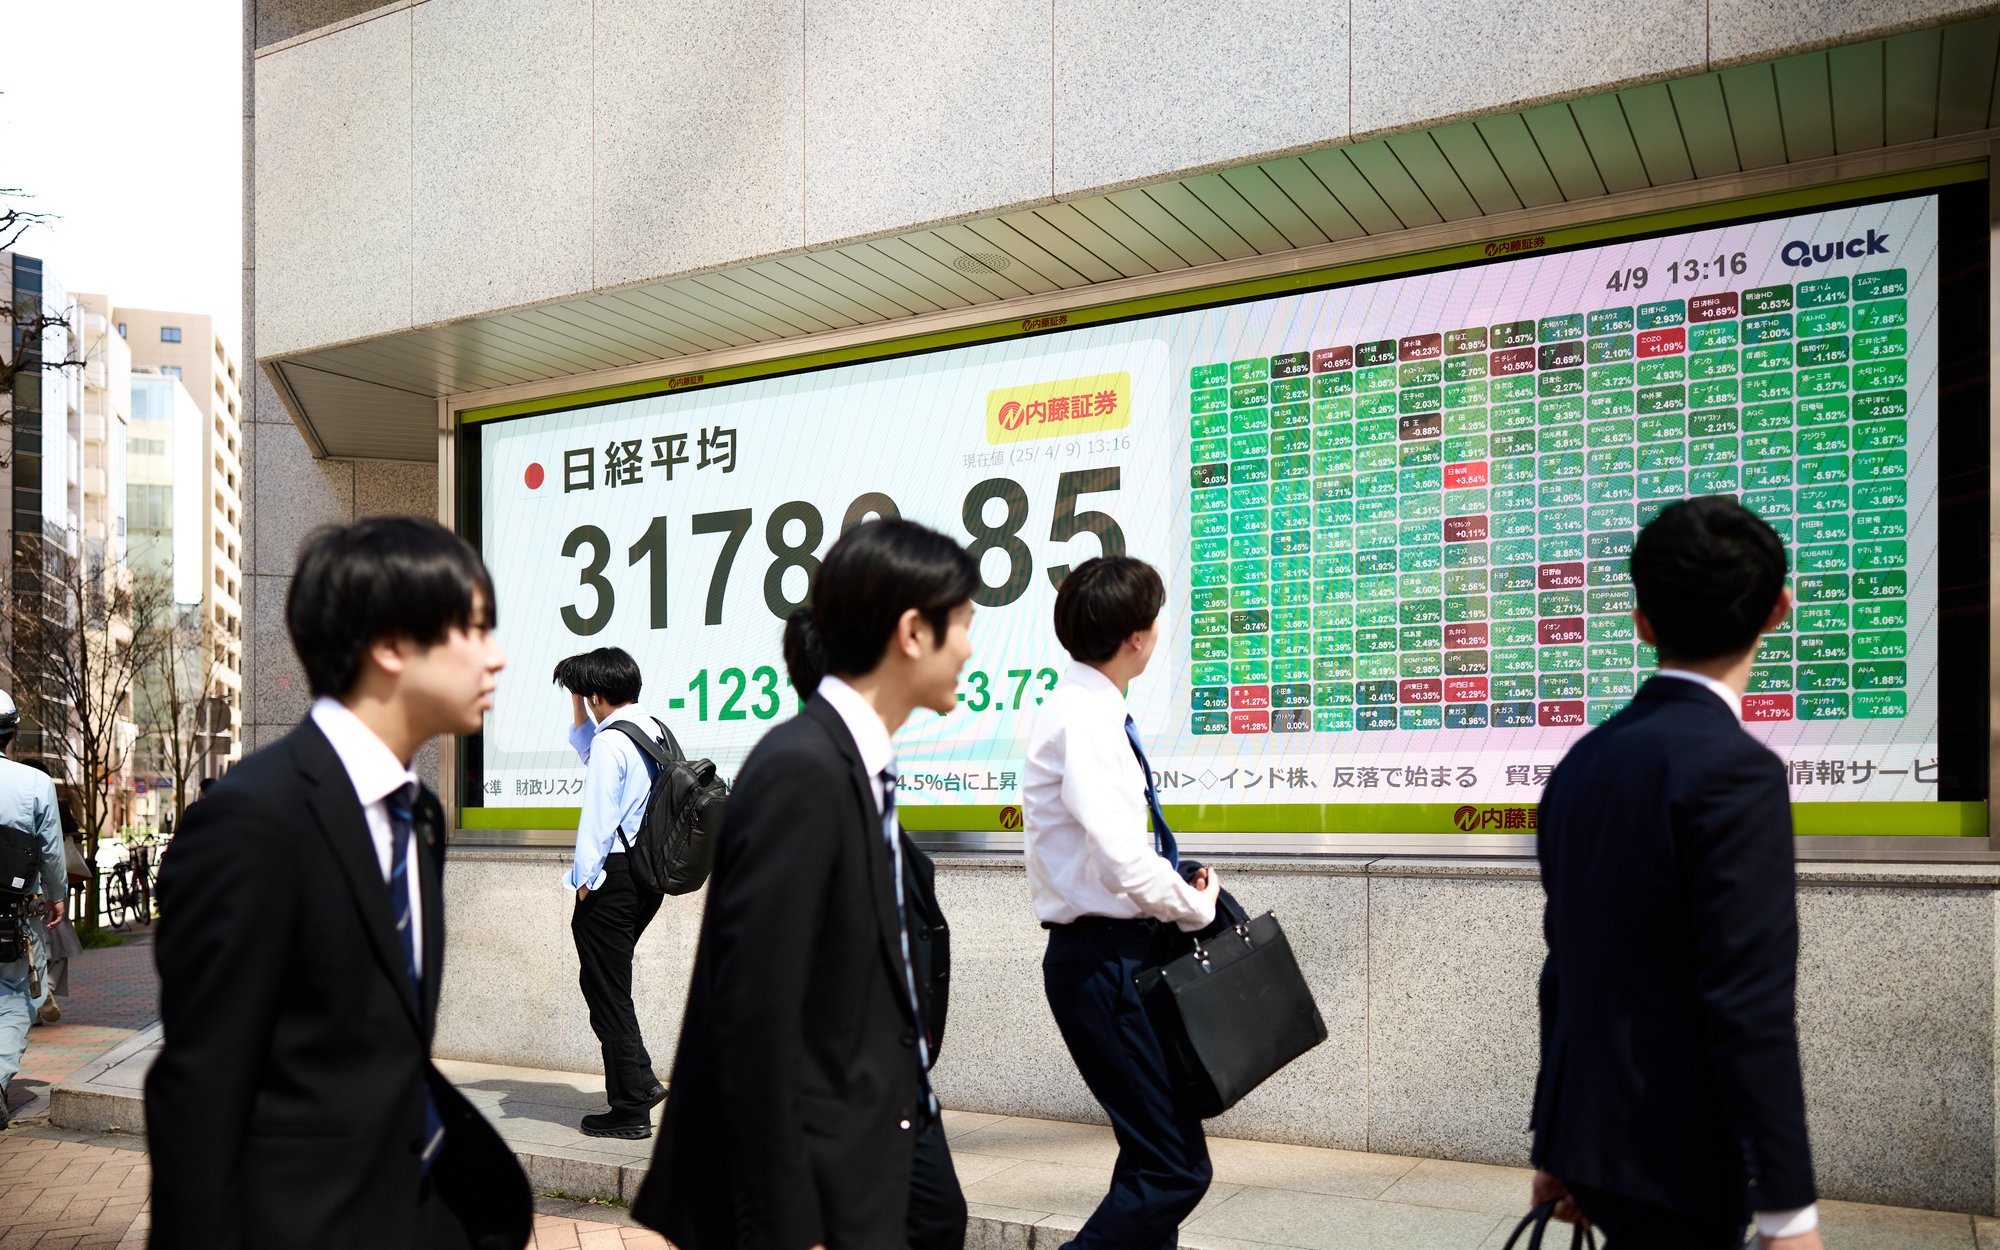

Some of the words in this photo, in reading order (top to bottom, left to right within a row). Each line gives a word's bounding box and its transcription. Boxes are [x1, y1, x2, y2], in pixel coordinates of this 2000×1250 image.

[1499, 236, 1546, 253] 内藤証券
[1606, 266, 1648, 293] 4/9
[1667, 252, 1747, 285] 13:16
[1801, 283, 1830, 293] 日本ハム
[1869, 283, 1904, 296] -2.88%
[1813, 291, 1846, 303] -1.41%
[1758, 299, 1790, 310] -0.53%
[1702, 306, 1735, 318] +0.69%
[1032, 314, 1068, 330] 内藤証券
[1652, 313, 1682, 324] -2.93%
[1869, 314, 1904, 326] -7.88%
[1813, 321, 1846, 333] -3.38%
[1641, 335, 1661, 343] ZOZO
[1758, 328, 1790, 340] -2.00%
[1704, 335, 1735, 346] -5.46%
[1410, 346, 1439, 356] +0.23%
[1650, 342, 1682, 353] +1.09%
[1869, 344, 1904, 356] -5.35%
[1494, 353, 1517, 362] ニチレイ
[1813, 351, 1846, 362] -1.15%
[1323, 358, 1350, 368] +0.69%
[1502, 361, 1532, 371] +0.55%
[1640, 362, 1664, 371] トクヤマ
[1758, 357, 1790, 369] -4.97%
[1652, 370, 1682, 381] -4.93%
[1869, 374, 1904, 386] -5.13%
[676, 374, 704, 388] 内藤証券
[1746, 379, 1766, 388] テルモ
[1812, 380, 1846, 392] -5.27%
[1758, 387, 1790, 398] -3.51%
[1025, 390, 1117, 426] 内藤証券
[1652, 399, 1682, 409] -2.46%
[1869, 404, 1904, 415] -2.03%
[1758, 416, 1790, 427] -3.72%
[1704, 422, 1735, 432] -2.21%
[1858, 426, 1885, 434] しずおか
[1869, 434, 1904, 445] -3.87%
[963, 450, 1004, 468] 現在値
[1088, 436, 1130, 454] 13:16
[1758, 445, 1790, 456] -6.67%
[563, 427, 738, 493] 日経平均
[1456, 475, 1485, 484] +3.54%
[1812, 470, 1846, 480] -5.97%
[1704, 480, 1735, 490] -3.03%
[1758, 504, 1790, 514] -5.87%
[1812, 500, 1846, 510] -6.17%
[1456, 529, 1485, 538] +0.11%
[1812, 529, 1846, 539] -5.94%
[1869, 525, 1903, 535] -5.73%
[1801, 549, 1832, 557] SUBARU
[1812, 559, 1846, 569] -4.90%
[1869, 555, 1903, 565] -5.13%
[1550, 576, 1581, 585] +0.50%
[1812, 589, 1846, 598] -1.59%
[1869, 585, 1903, 595] -2.80%
[1812, 618, 1846, 628] -4.77%
[1869, 615, 1903, 625] -5.06%
[1456, 636, 1485, 645] +0.26%
[1550, 632, 1581, 640] +0.95%
[1757, 650, 1790, 659] -2.27%
[1812, 648, 1846, 657] -1.94%
[1869, 646, 1903, 655] -3.01%
[1812, 678, 1846, 686] -1.27%
[1869, 676, 1903, 685] -1.88%
[1755, 709, 1790, 717] +1.79%
[1812, 707, 1846, 716] -2.64%
[516, 777, 586, 797] 財政リスク
